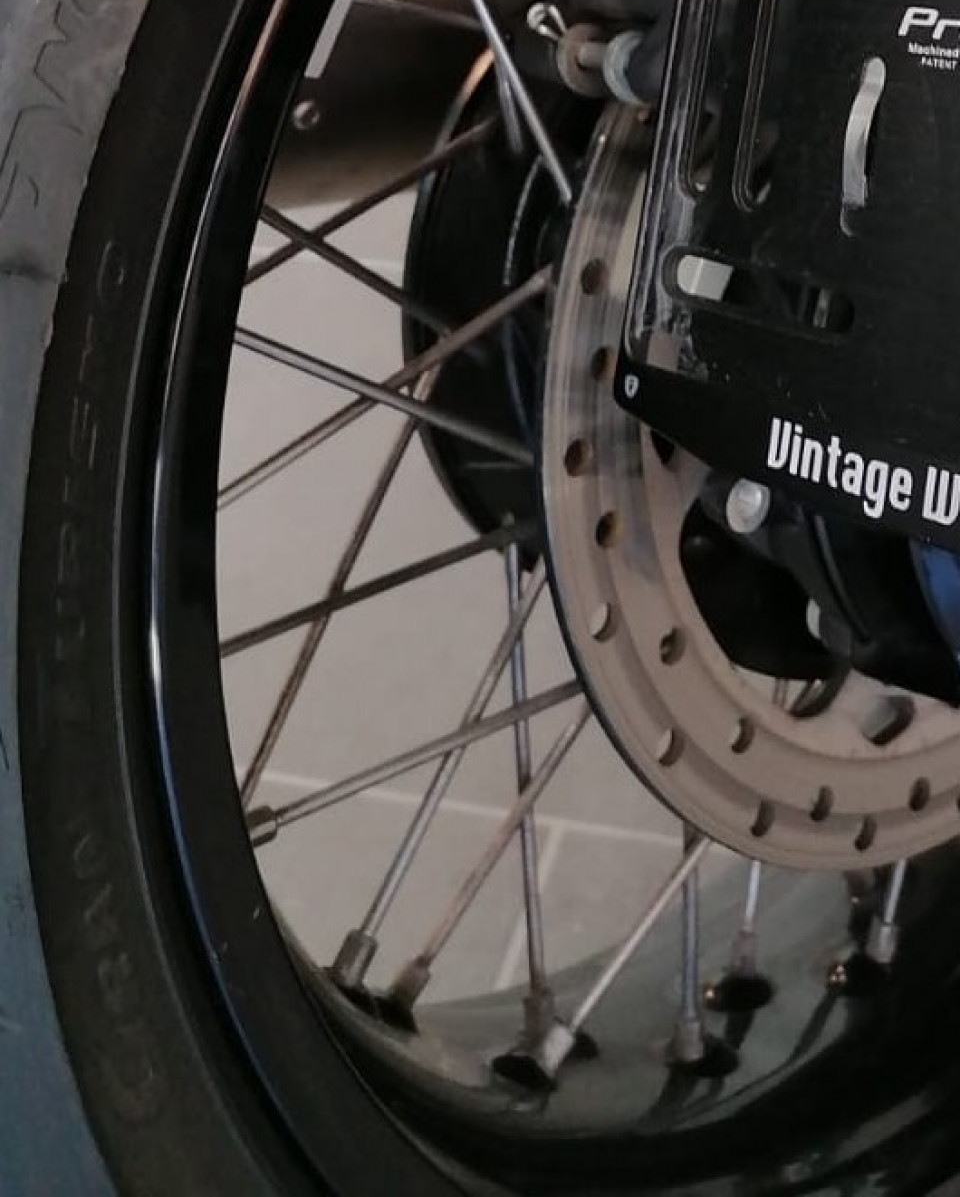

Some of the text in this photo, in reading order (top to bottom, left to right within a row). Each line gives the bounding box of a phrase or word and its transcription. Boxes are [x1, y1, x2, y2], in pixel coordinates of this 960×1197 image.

[908, 42, 960, 59] Machined
[921, 56, 957, 71] PATENT
[767, 417, 913, 519] Vintage
